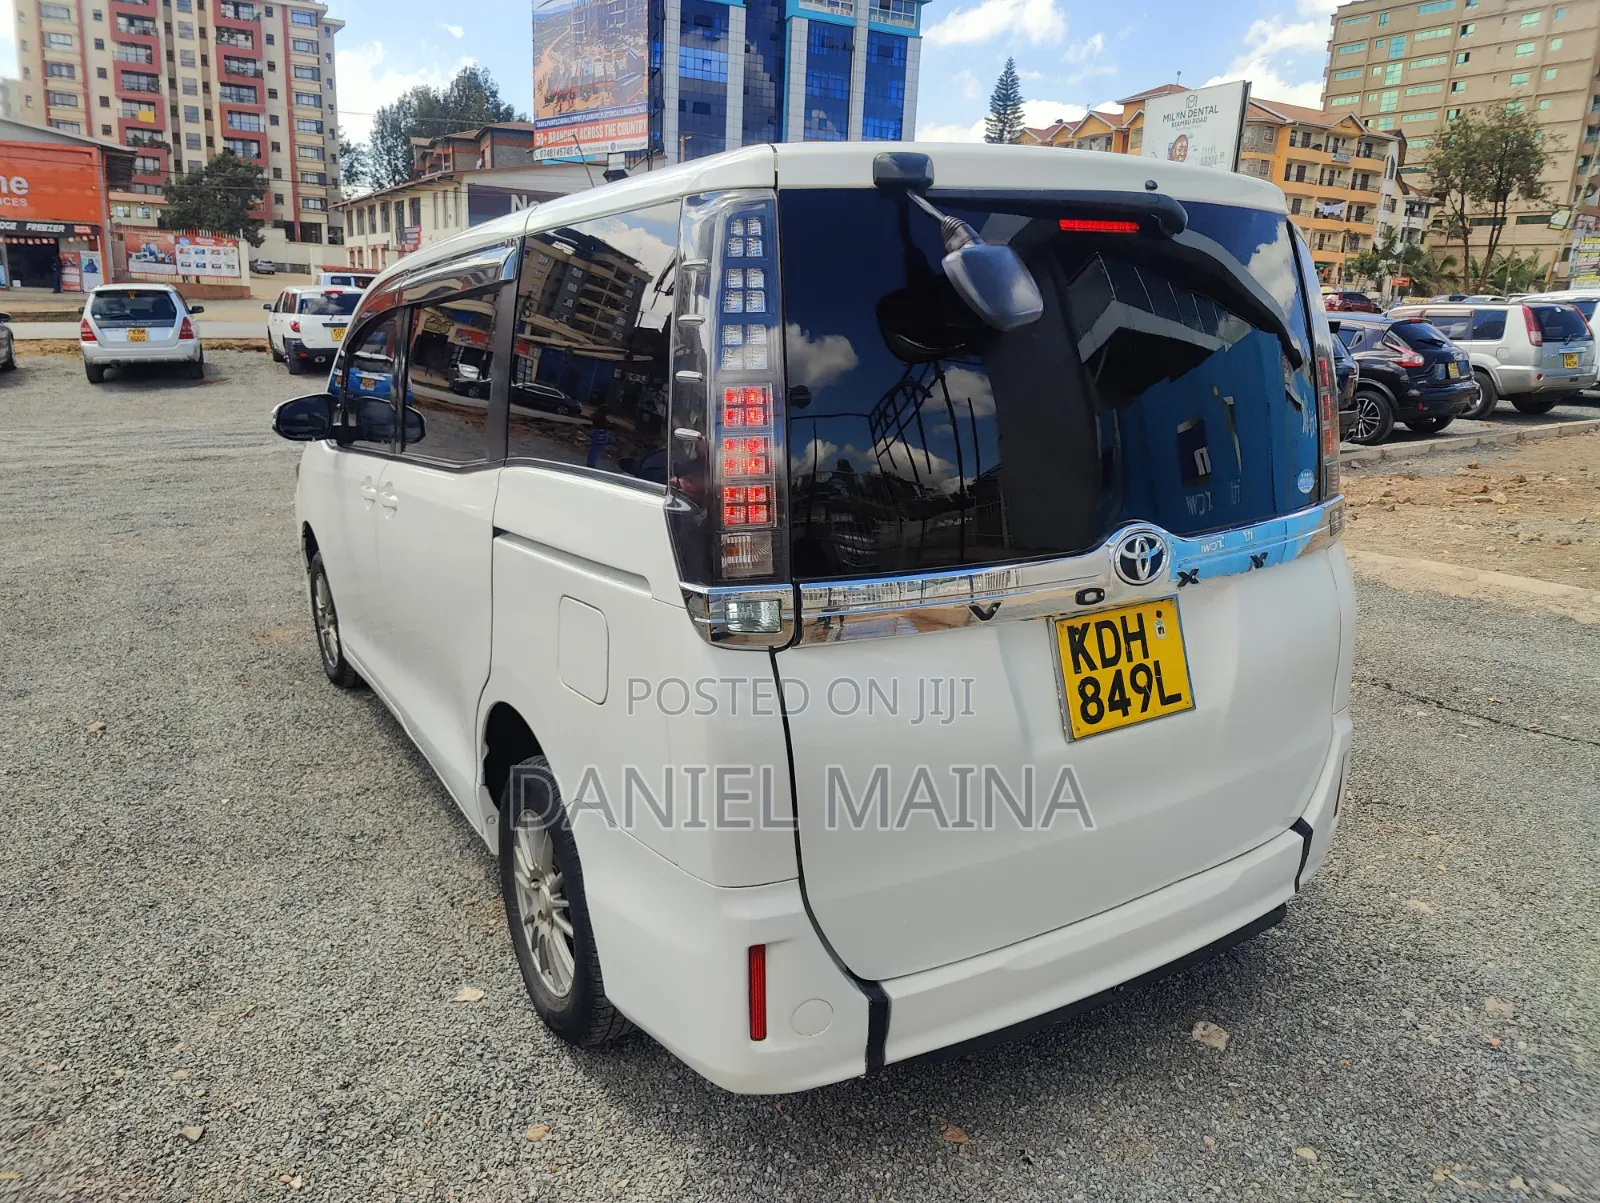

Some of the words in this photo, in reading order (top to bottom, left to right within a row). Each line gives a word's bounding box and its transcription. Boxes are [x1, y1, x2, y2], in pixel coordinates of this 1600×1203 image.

[1187, 105, 1219, 118] DENTAL
[1171, 119, 1192, 128] KIAMBU
[1192, 116, 1208, 124] ROAD
[536, 133, 548, 147] 50+
[548, 129, 578, 144] BRANCHES
[580, 126, 603, 140] ACROSS
[604, 123, 618, 138] THE
[617, 119, 648, 136] COUNTRY
[540, 146, 574, 158] 0748145745
[0, 197, 28, 207] CES
[26, 222, 66, 233] FREEZER
[1067, 612, 1149, 675] KDH
[1077, 660, 1182, 725] 849L
